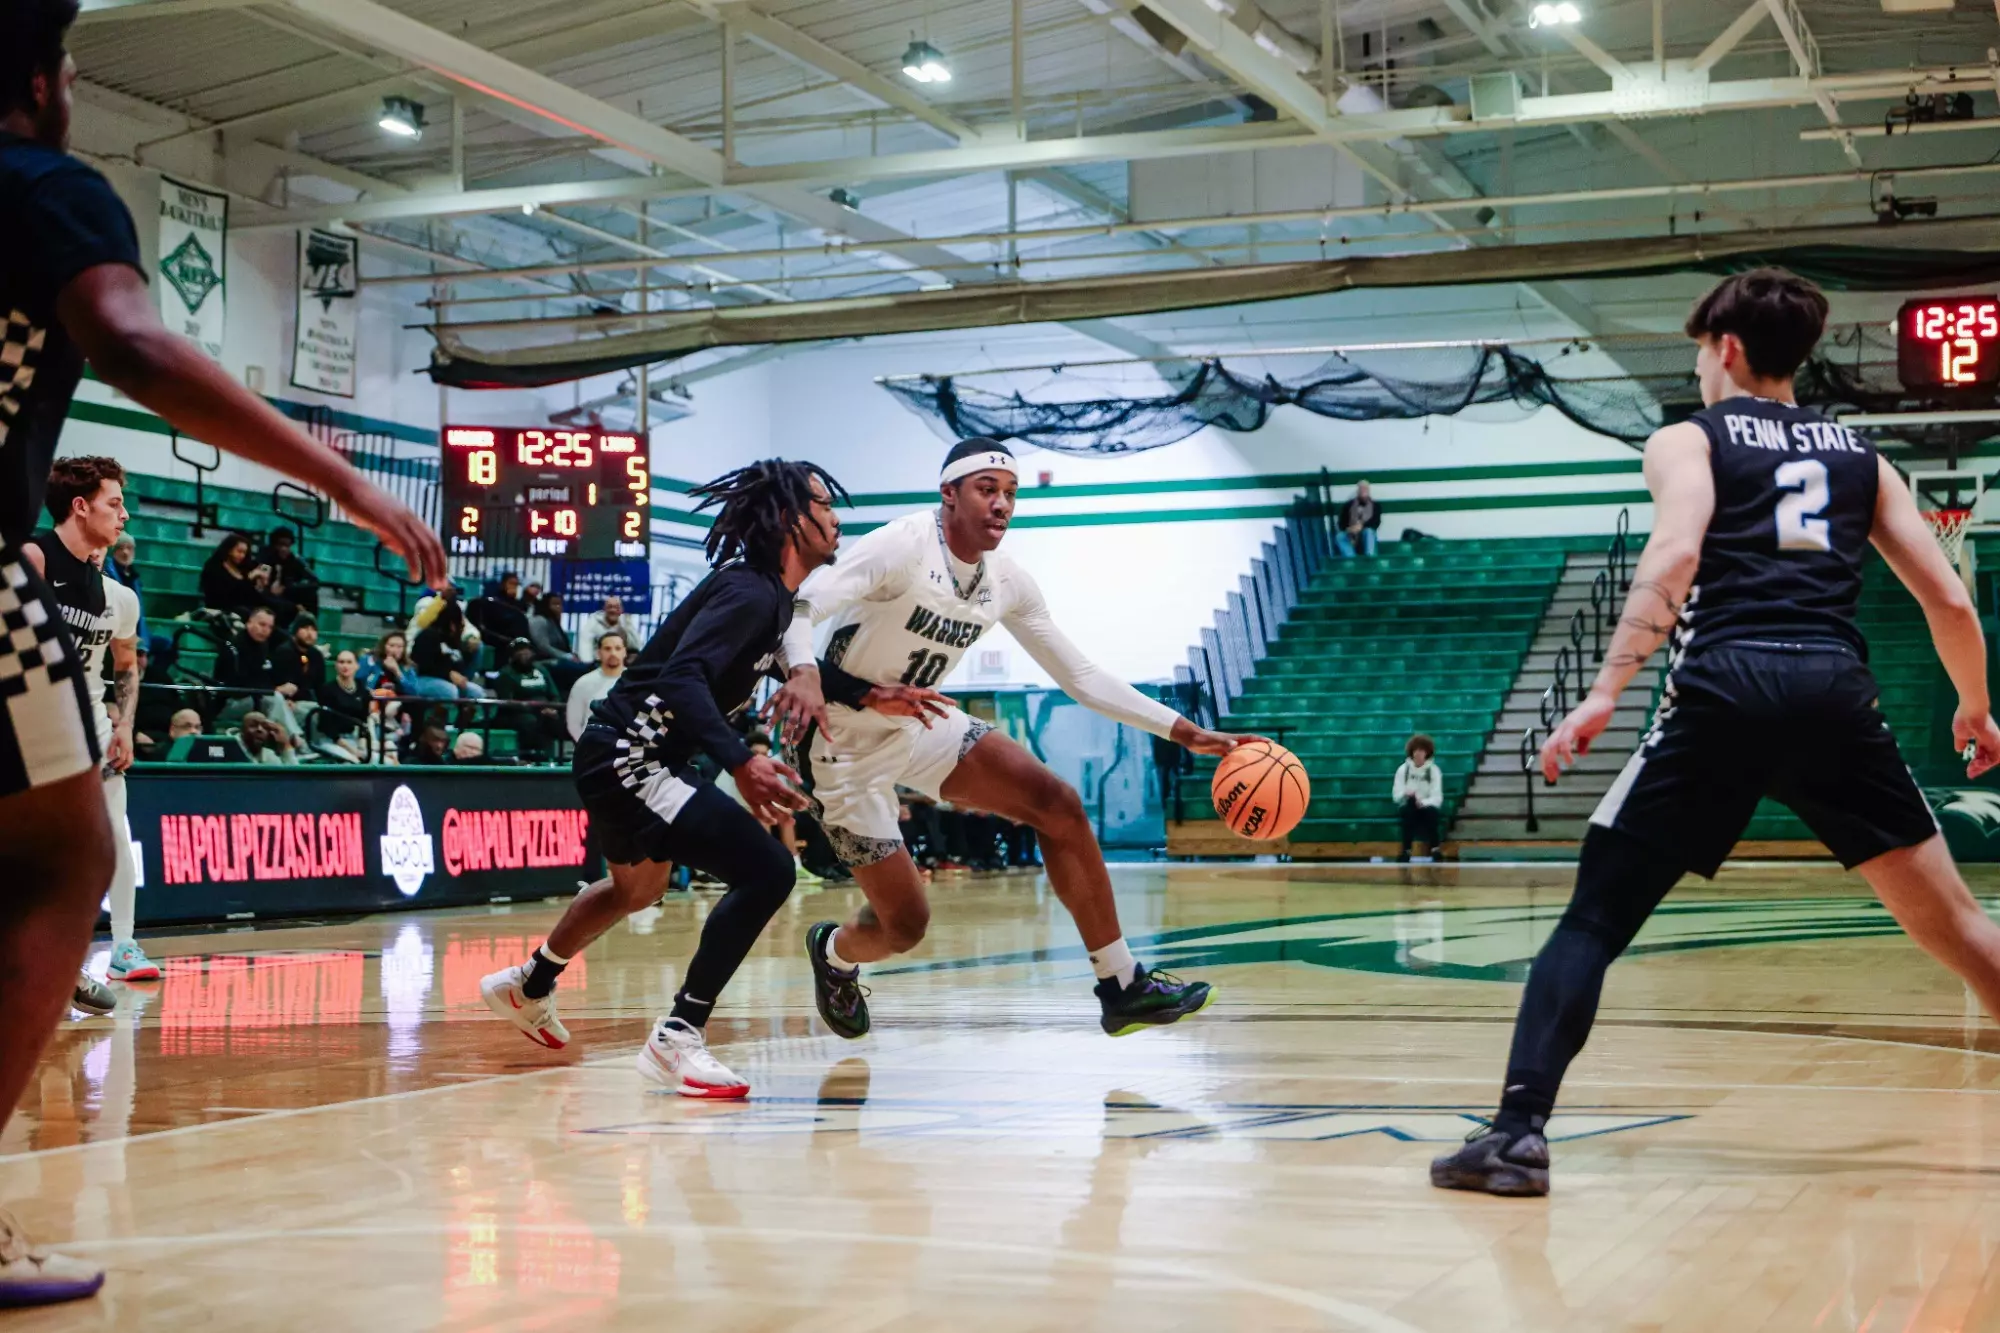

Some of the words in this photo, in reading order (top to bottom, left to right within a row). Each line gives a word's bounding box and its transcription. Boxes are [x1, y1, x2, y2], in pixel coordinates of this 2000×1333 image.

[1916, 304, 1998, 339] 12:25
[1942, 338, 1978, 382] 12
[518, 431, 593, 467] 12:25
[1724, 414, 1789, 451] PENN
[1792, 420, 1866, 454] STATE
[468, 450, 497, 485] 18
[626, 456, 648, 490] 5
[529, 486, 570, 503] period
[588, 482, 597, 506] 1
[1774, 459, 1831, 551] 2
[461, 506, 479, 533] 2
[623, 511, 641, 537] 2
[904, 605, 983, 649] WAGNER
[899, 648, 949, 688] 10
[160, 812, 365, 885] NAPOLIPIZZASI.COM
